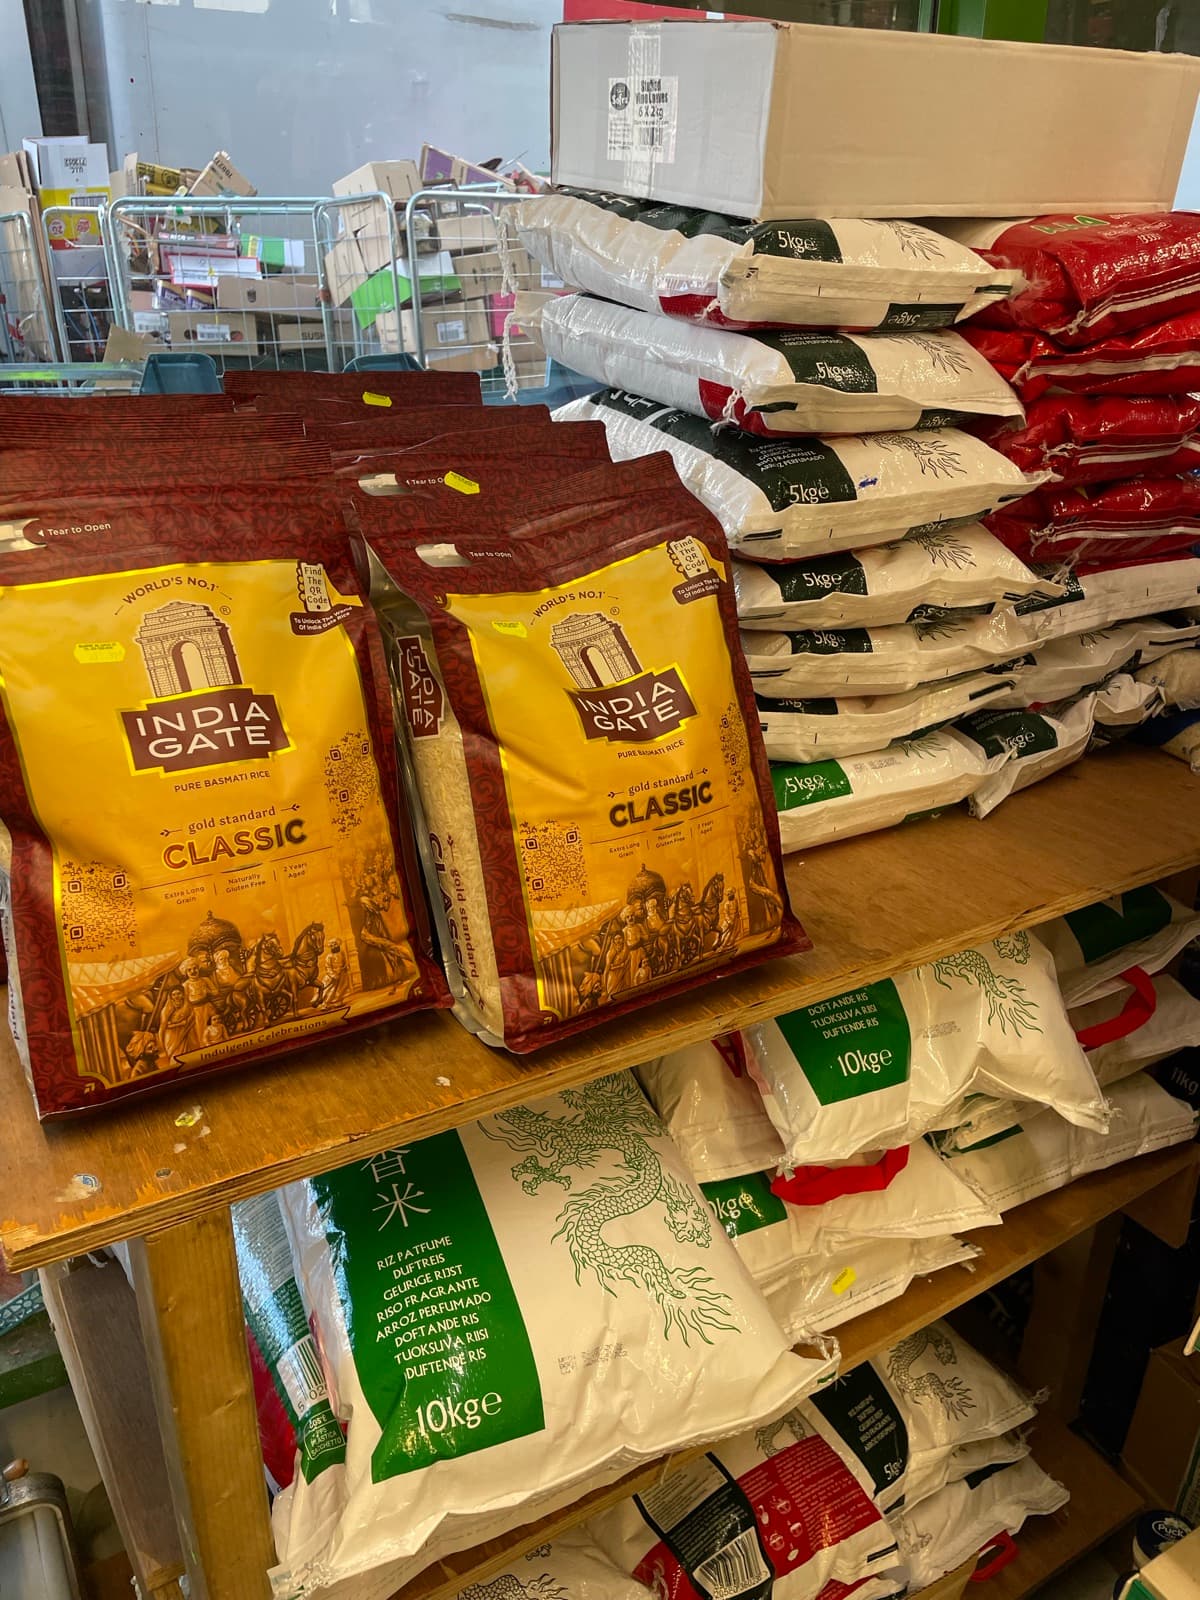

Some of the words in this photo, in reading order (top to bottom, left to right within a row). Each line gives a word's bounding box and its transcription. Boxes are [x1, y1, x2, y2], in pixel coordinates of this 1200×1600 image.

[411, 477, 427, 486] Tear
[428, 477, 437, 486] to
[48, 526, 71, 538] Tear
[72, 526, 82, 536] to
[84, 523, 112, 535] Open
[469, 550, 484, 559] Tear
[485, 550, 494, 559] to
[673, 539, 693, 551] Find
[679, 546, 696, 556] The
[685, 552, 699, 563] QR
[685, 559, 706, 571] Code
[304, 566, 322, 576] Find
[307, 576, 322, 585] The
[801, 571, 843, 588] 5kge
[122, 576, 183, 604] WORLD'S
[306, 596, 328, 604] Code
[309, 586, 322, 596] QR
[532, 592, 576, 618] WORLD'S
[578, 681, 675, 716] INDIA
[136, 701, 271, 738] INDIA
[593, 698, 680, 732] GATE
[148, 726, 271, 760] GATE
[618, 748, 637, 759] PURE
[666, 739, 685, 752] RICE
[174, 782, 202, 792] PURE
[204, 774, 248, 788] BASMATI
[250, 770, 271, 779] RICE
[628, 781, 651, 797] gold
[652, 769, 694, 787] standard
[609, 780, 713, 828] CLASSIC
[188, 817, 216, 835] gold
[219, 806, 276, 826] standard
[163, 818, 307, 870] CLASSIC
[225, 884, 250, 894] Gluten
[250, 880, 266, 888] Free
[228, 873, 261, 885] Naturally
[288, 870, 306, 879] Aged
[164, 890, 185, 900] Extra
[186, 886, 205, 896] Long
[176, 896, 197, 905] Grain
[450, 868, 468, 903] gold
[459, 907, 480, 979] standard
[856, 992, 869, 1004] RIS
[822, 1020, 867, 1040] DUFTENDE
[866, 1016, 880, 1028] RIS
[200, 1038, 254, 1061] Indulgent
[257, 1020, 328, 1044] Celebrations
[376, 1254, 396, 1271] RIZ
[393, 1253, 446, 1280] DUFTREIS
[383, 1272, 433, 1300] GEURIGE
[434, 1264, 463, 1280] RIJST
[376, 1302, 403, 1323] RISO
[404, 1277, 480, 1308] FRAGRANTE
[376, 1311, 418, 1342] ARROZ
[418, 1291, 492, 1320] PERFUMADO
[394, 1316, 460, 1348] DOFTANDE
[462, 1312, 480, 1326] RIS
[394, 1334, 466, 1365] TUOKSUVA
[466, 1328, 490, 1344] RIISI
[405, 1351, 467, 1380] DUFTENDE
[468, 1347, 487, 1362] RIS
[296, 1401, 306, 1413] 5
[414, 1392, 503, 1438] 10kge
